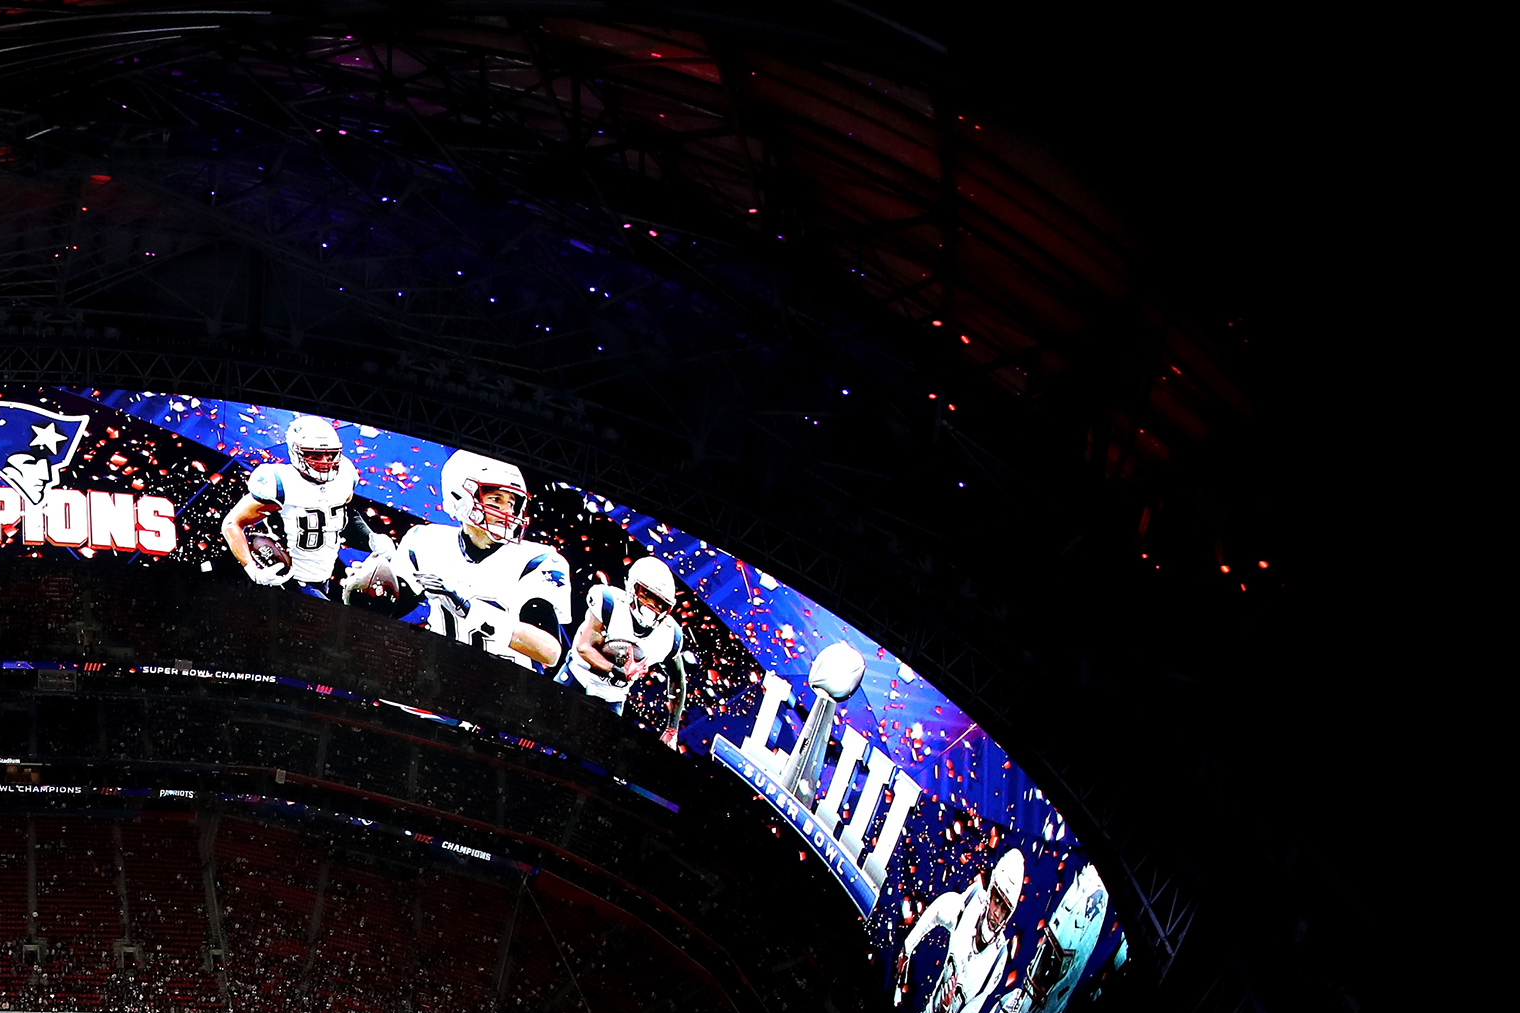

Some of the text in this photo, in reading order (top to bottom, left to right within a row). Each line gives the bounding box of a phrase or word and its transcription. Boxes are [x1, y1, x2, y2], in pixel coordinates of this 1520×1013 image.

[297, 502, 348, 552] 87
[141, 666, 277, 684] SUPER BOWL CHAMPIONS
[17, 785, 83, 795] CHAMPIONS
[740, 669, 923, 895] LIII
[159, 789, 195, 799] PATRIOTS
[742, 763, 846, 875] SUPER BOWL
[441, 840, 491, 862] CHAMPIONS
